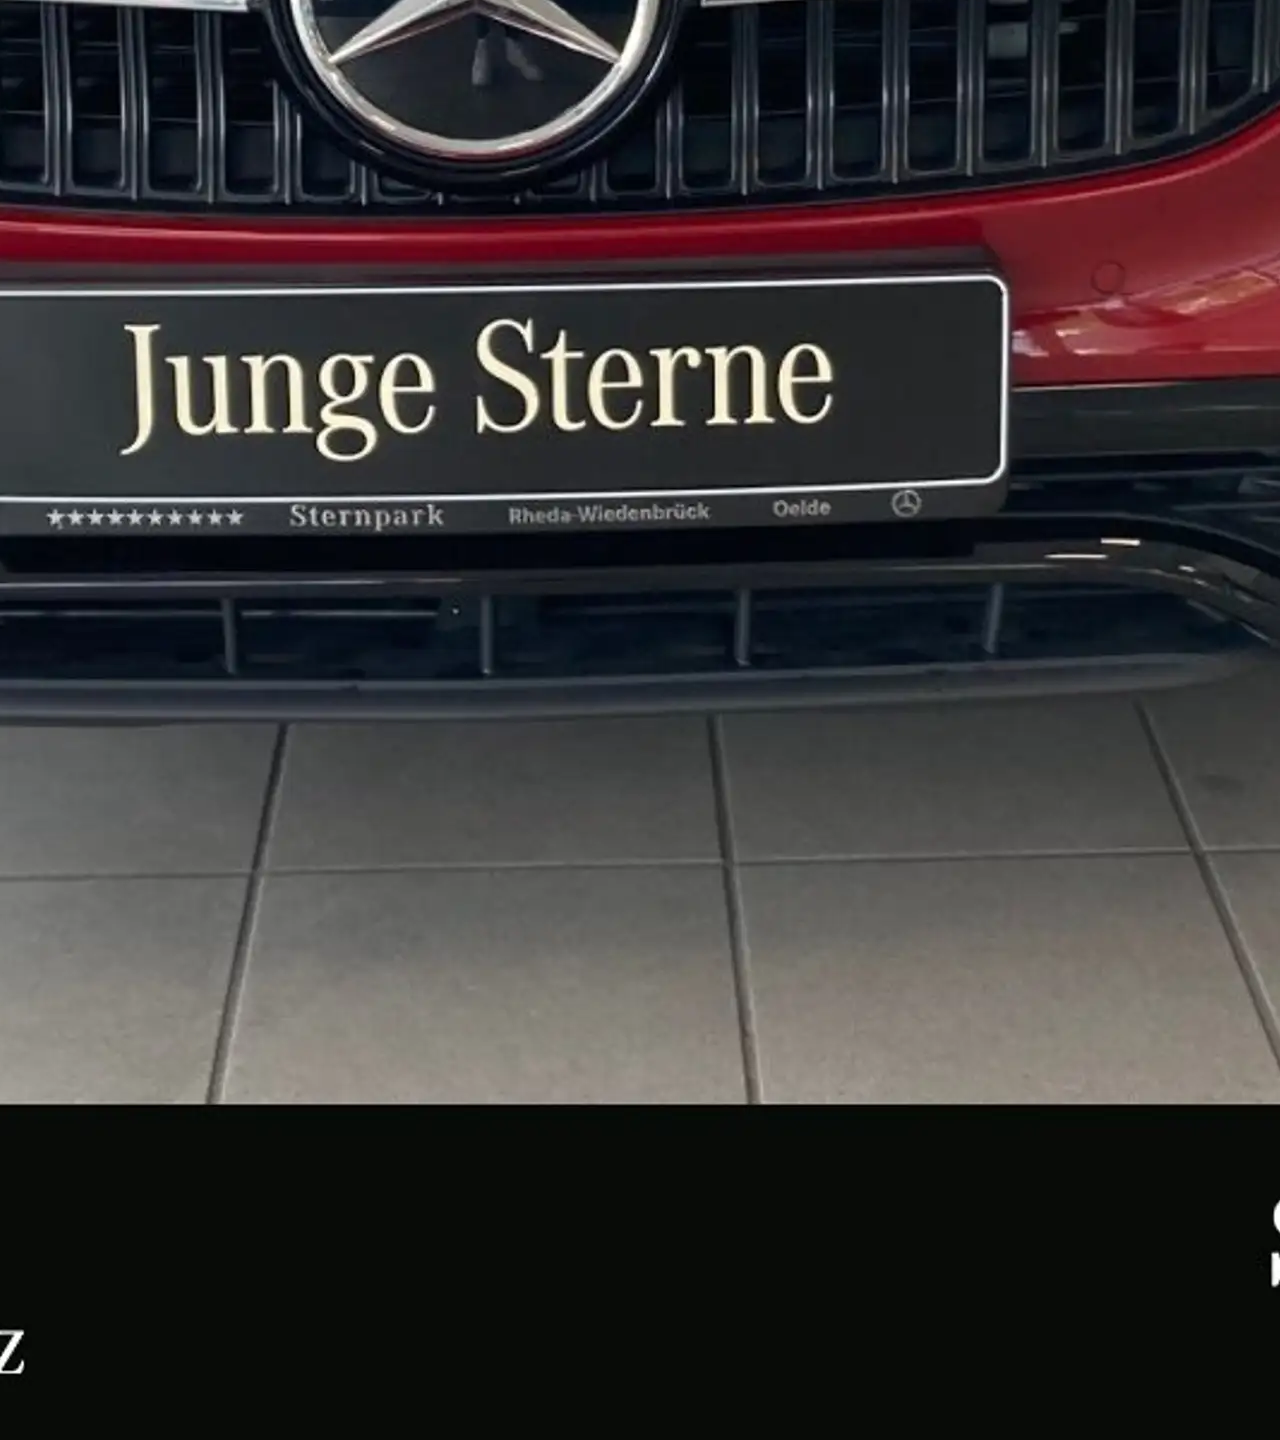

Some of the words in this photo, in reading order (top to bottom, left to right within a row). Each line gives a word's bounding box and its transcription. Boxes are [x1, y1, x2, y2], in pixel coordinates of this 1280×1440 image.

[121, 323, 436, 462] Junge
[476, 318, 834, 435] Sterne
[289, 503, 445, 532] Sternpark
[508, 502, 712, 525] Rheda-Wiedenbrück
[772, 498, 832, 518] Oelde
